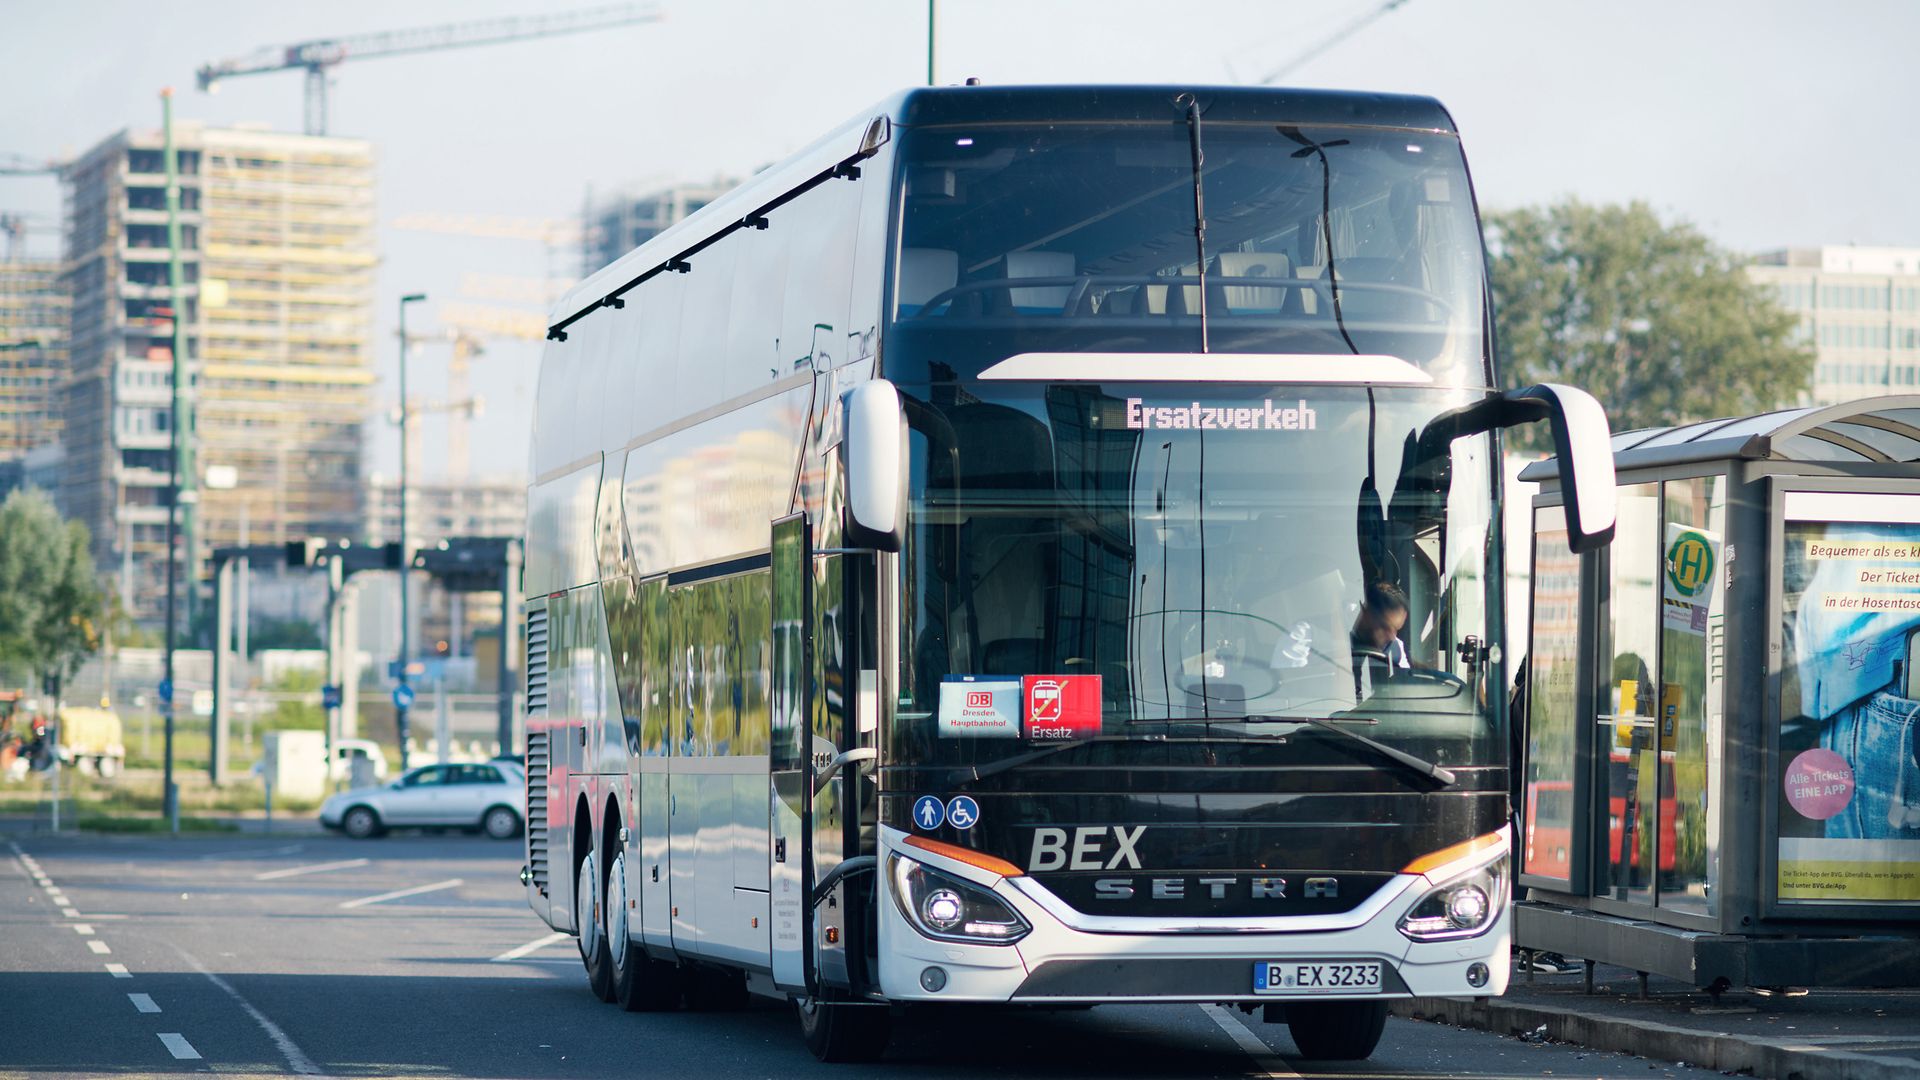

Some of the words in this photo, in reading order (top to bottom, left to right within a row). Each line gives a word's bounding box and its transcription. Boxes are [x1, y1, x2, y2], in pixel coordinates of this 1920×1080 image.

[1127, 398, 1316, 429] Ersatzverkeh
[1811, 545, 1870, 558] Bequemer
[1873, 546, 1890, 557] als
[1894, 549, 1906, 557] es
[1680, 544, 1703, 583] H
[1861, 571, 1882, 582] Der
[1825, 596, 1836, 607] in
[1840, 596, 1858, 607] der
[969, 694, 990, 706] DB
[962, 709, 995, 717] Dresden
[950, 720, 1006, 728] Hauptbahnhof
[1031, 725, 1072, 739] Ersatz
[1789, 773, 1809, 784] Alle
[1812, 770, 1849, 782] Tickets
[1795, 787, 1821, 799] EINE
[1824, 784, 1846, 796] APP
[1028, 825, 1147, 872] BEX
[1094, 877, 1338, 899] SETRA
[1269, 966, 1282, 986] B
[1297, 966, 1323, 986] EX
[1328, 966, 1379, 986] 3233
